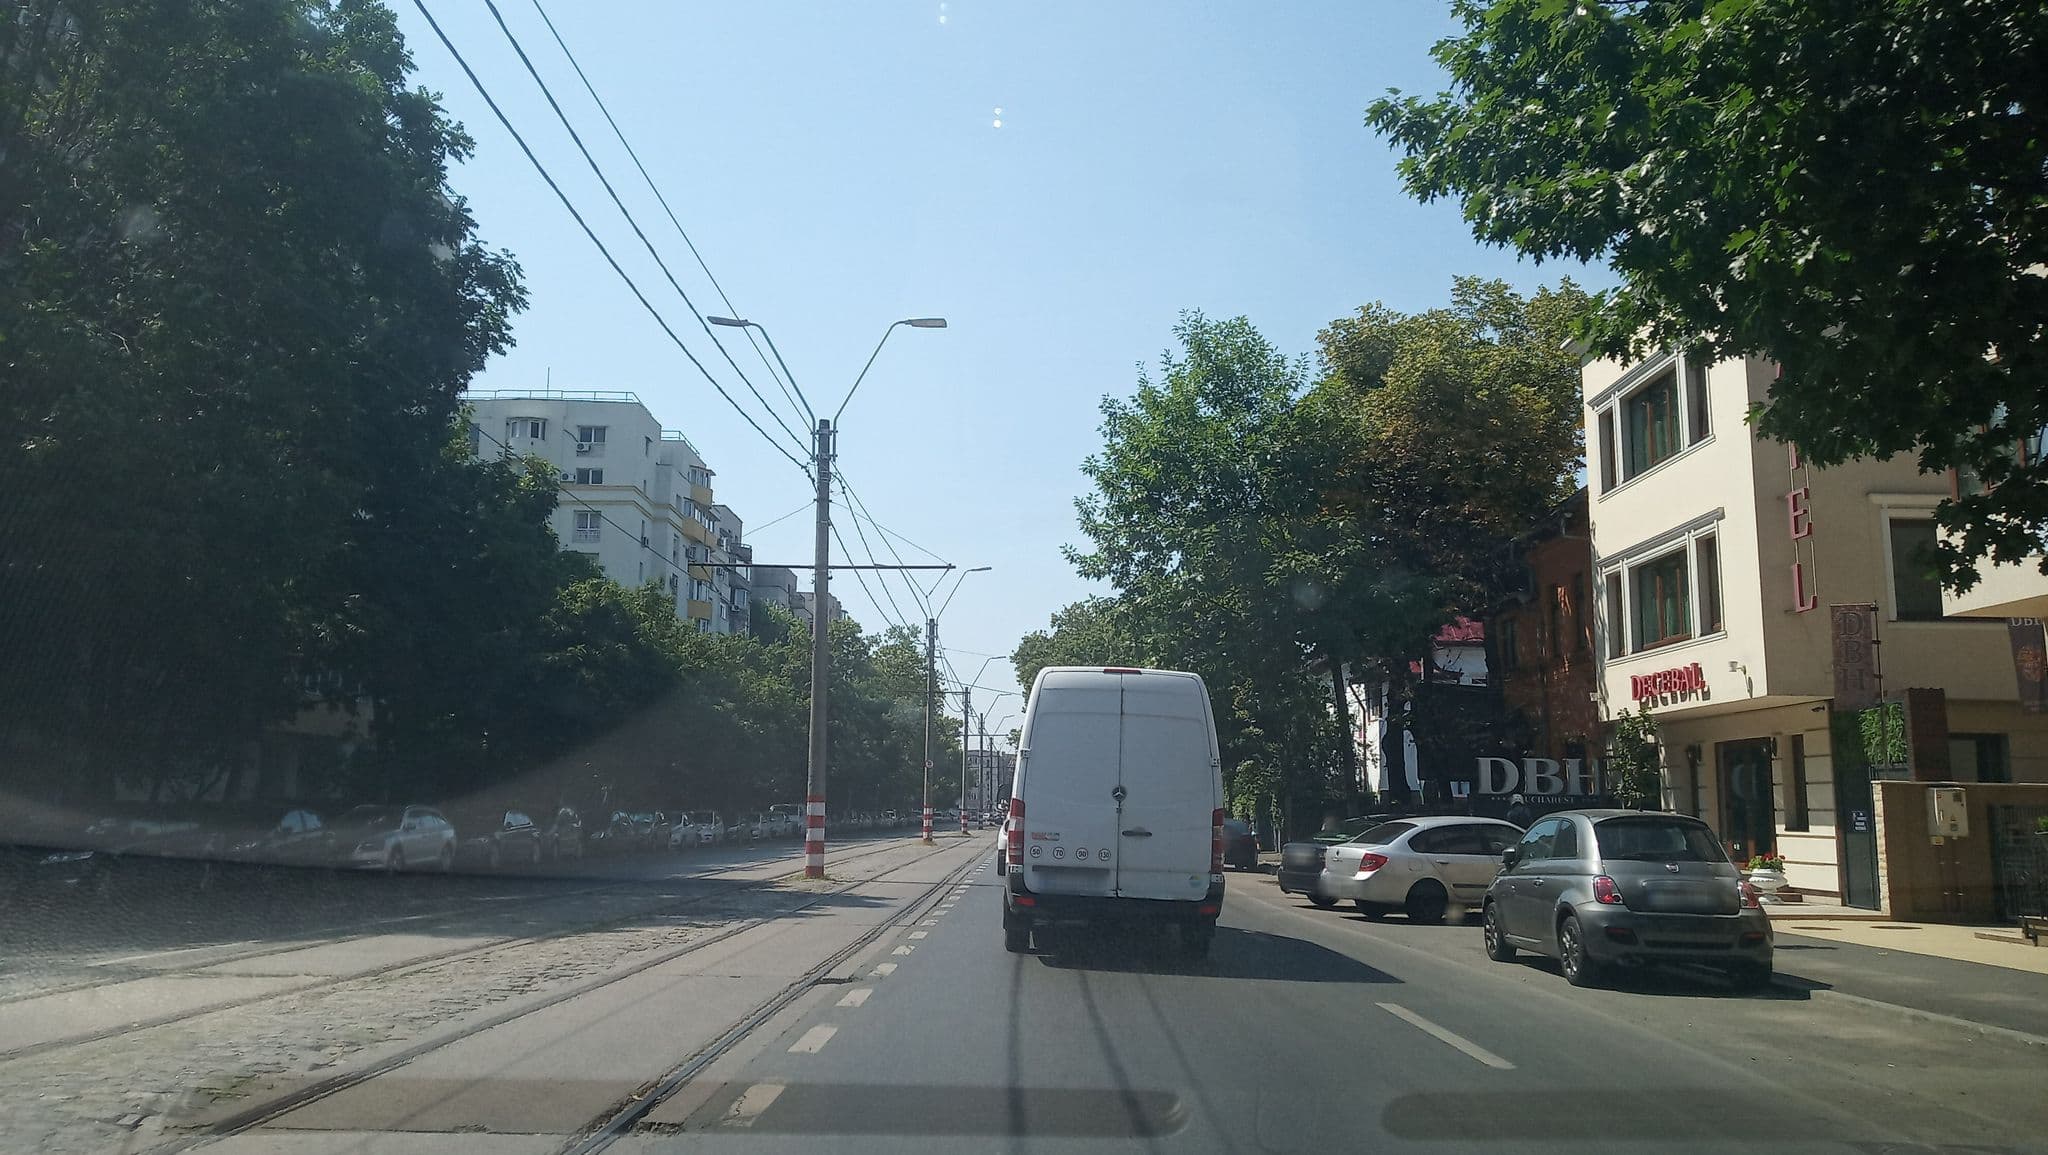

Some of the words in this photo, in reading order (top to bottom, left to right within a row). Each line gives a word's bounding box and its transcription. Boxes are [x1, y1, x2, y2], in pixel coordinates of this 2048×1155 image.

[1631, 663, 1705, 701] DECEBAL
[1475, 757, 1602, 795] DBH
[1519, 794, 1575, 804] UCHAREST
[1032, 848, 1041, 856] 50
[1055, 849, 1064, 857] 70
